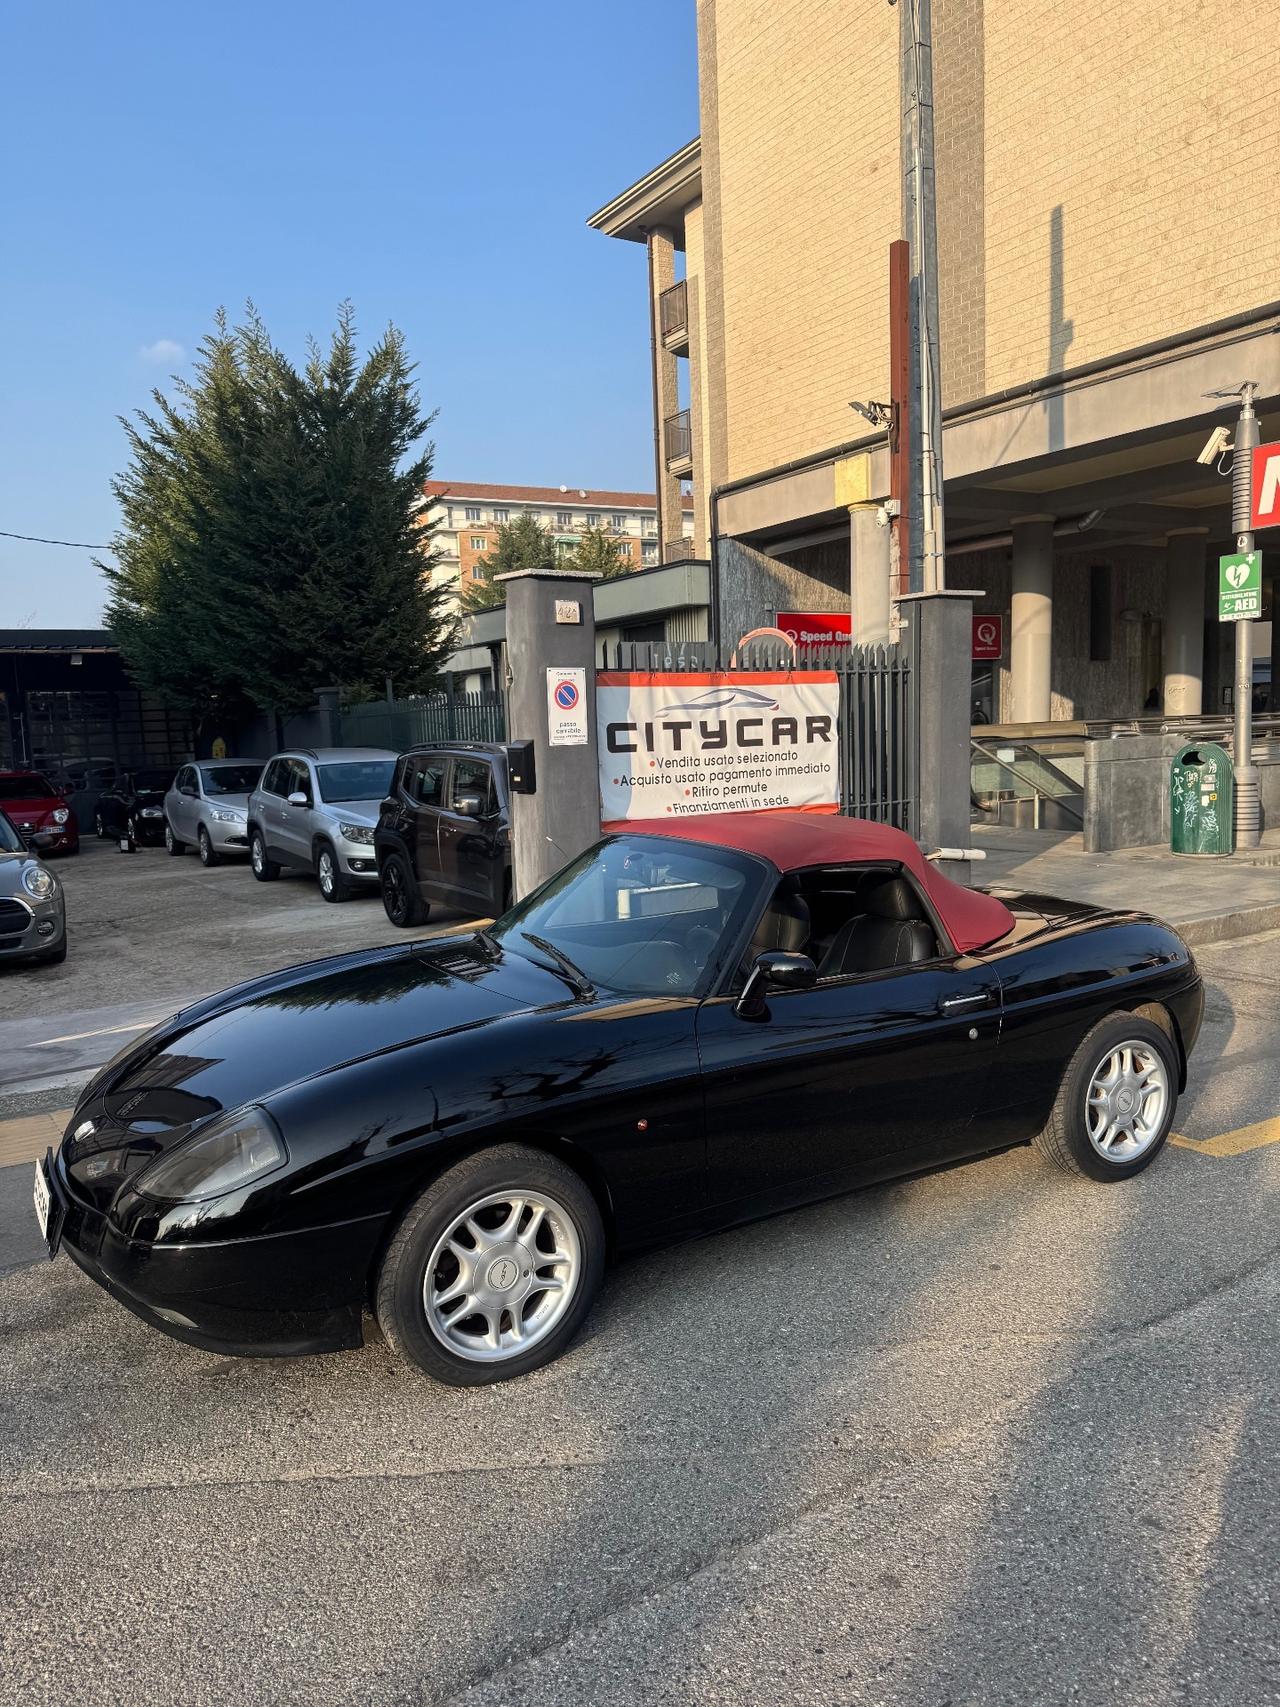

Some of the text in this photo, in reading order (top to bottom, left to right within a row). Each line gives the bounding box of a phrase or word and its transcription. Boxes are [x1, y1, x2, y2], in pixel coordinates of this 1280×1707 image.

[1234, 597, 1257, 611] AED
[800, 630, 833, 643] Speed
[606, 715, 832, 754] CITYCAR
[656, 750, 798, 768] Vendita usato selezionato
[620, 762, 831, 787] Acquisto usato pagamento immediato
[692, 782, 768, 798] Ritiro permute
[672, 794, 790, 814] Finanziamenti in sede
